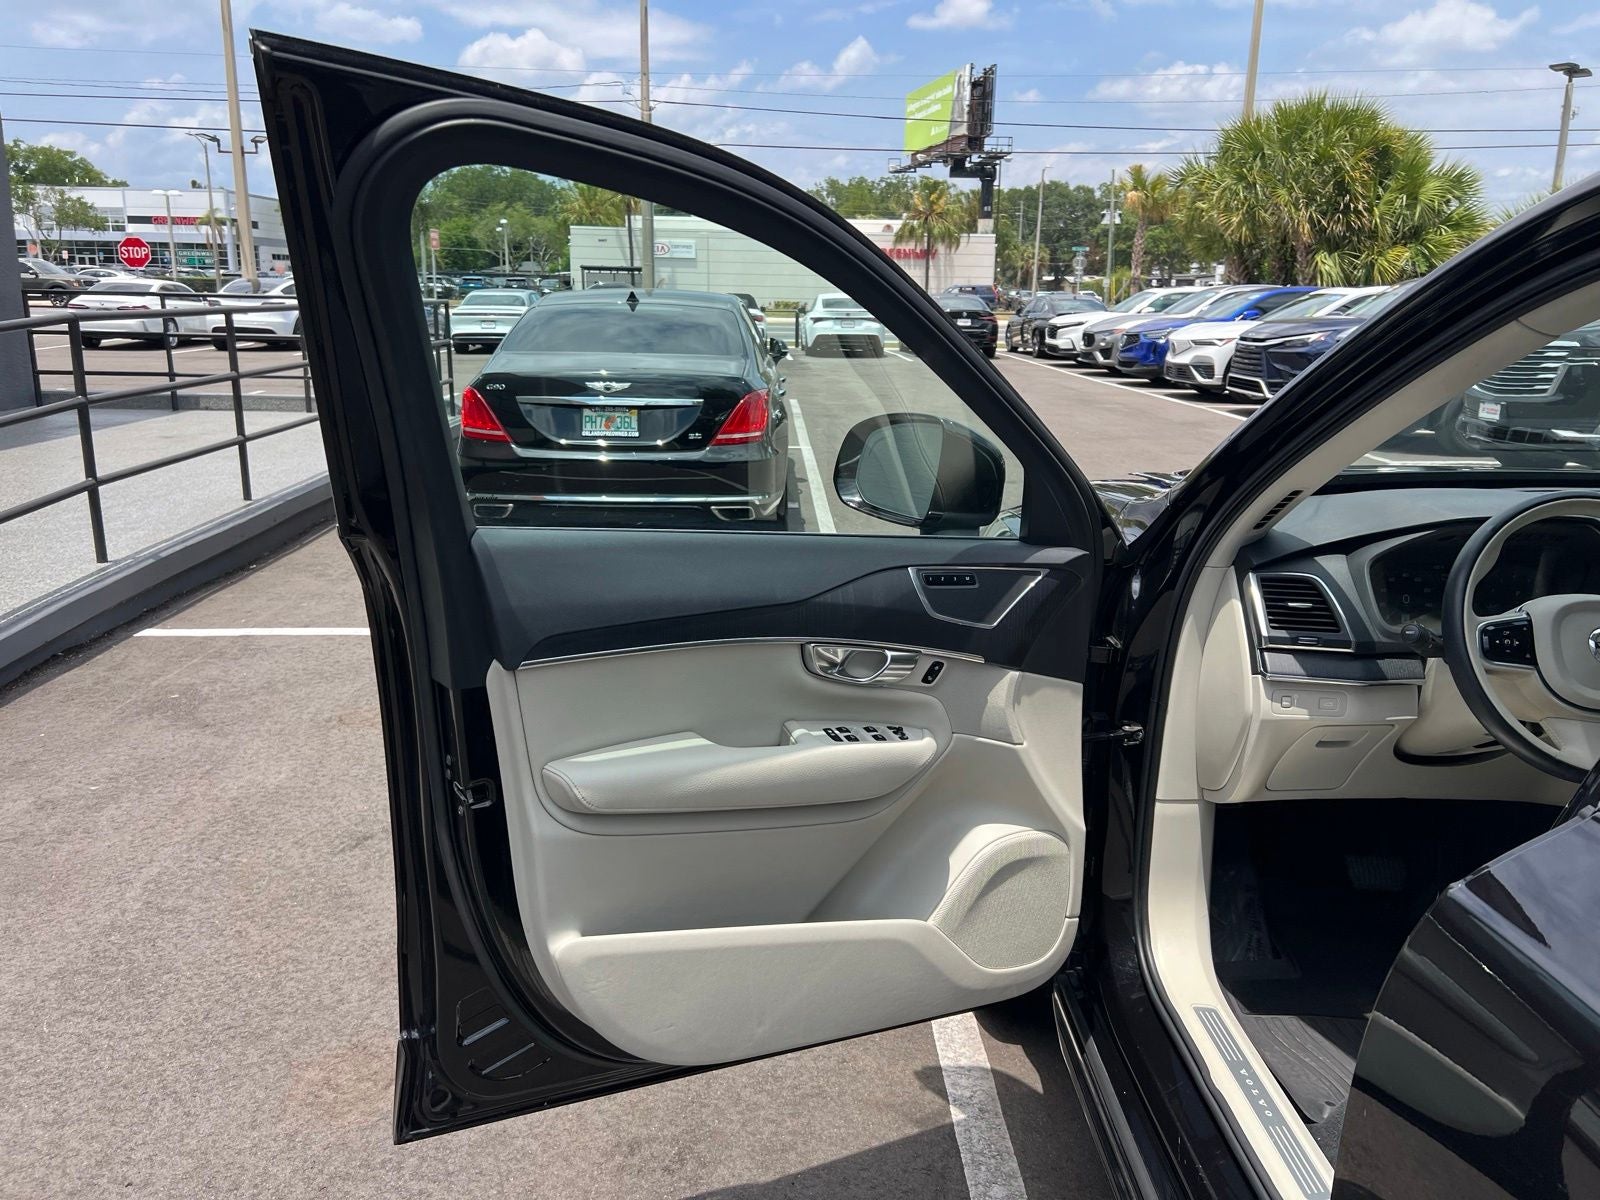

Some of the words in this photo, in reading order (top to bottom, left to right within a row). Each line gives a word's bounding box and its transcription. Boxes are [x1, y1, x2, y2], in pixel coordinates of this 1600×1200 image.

[121, 246, 148, 259] STOP
[584, 415, 603, 429] PH7
[616, 415, 636, 430] 36L
[1239, 1068, 1273, 1117] VOLVO
